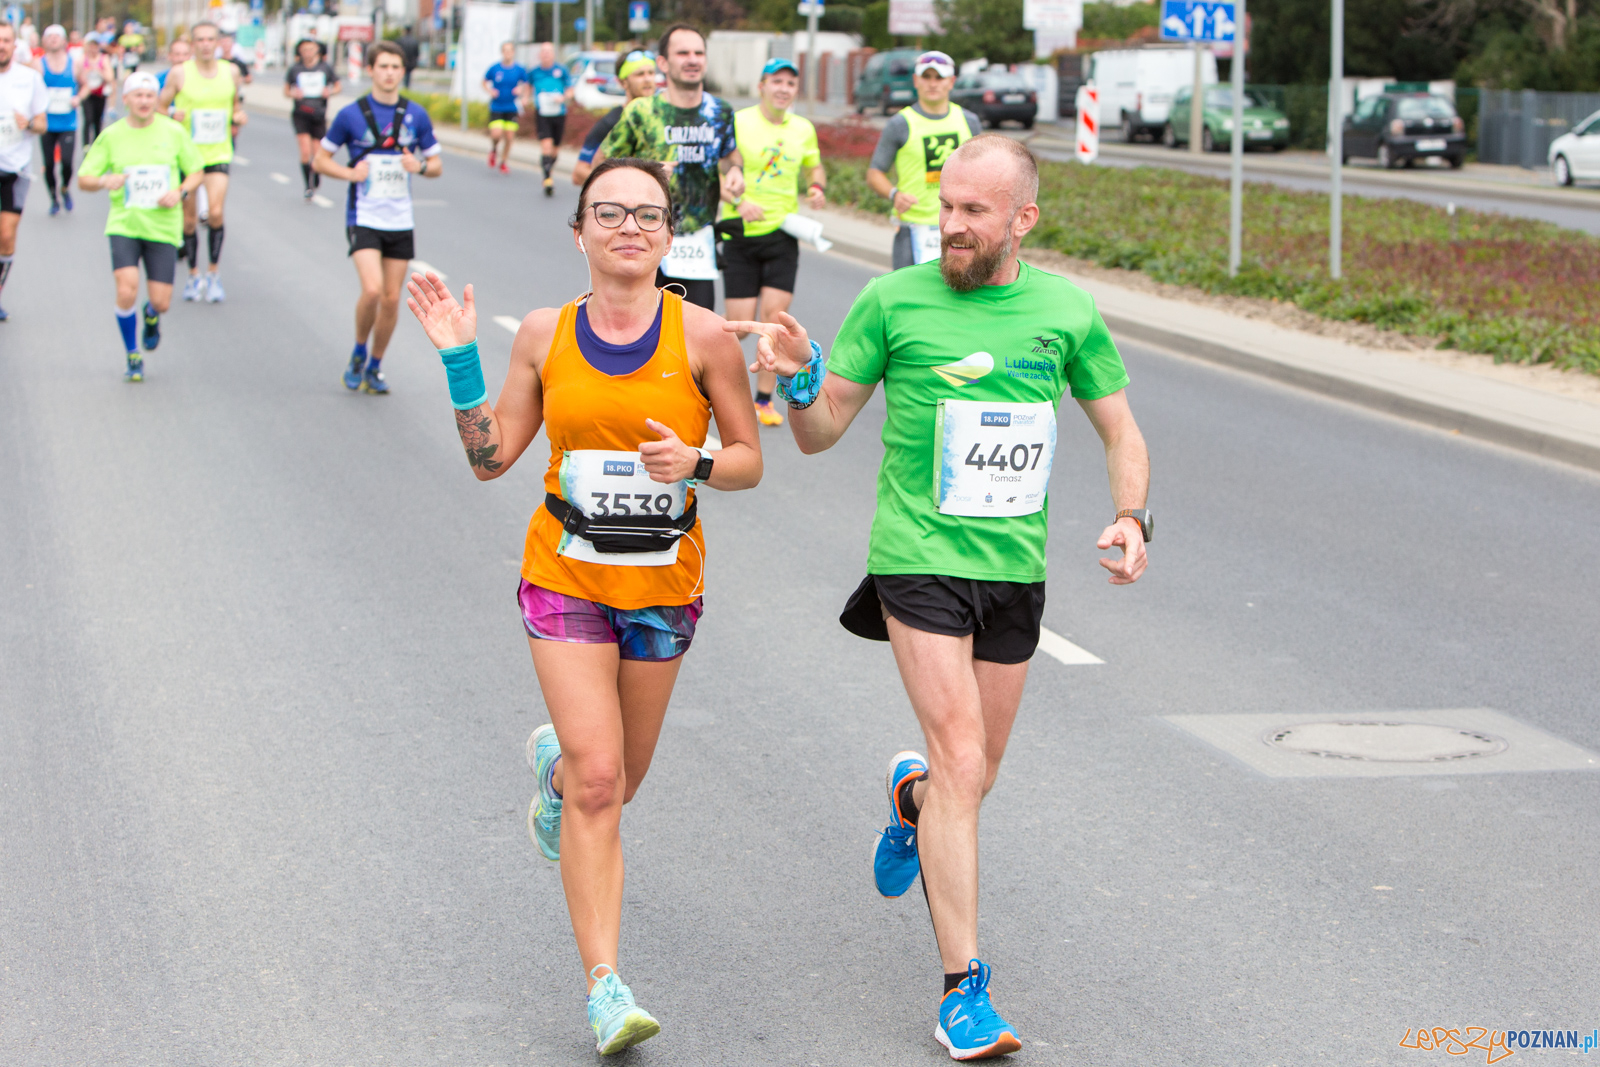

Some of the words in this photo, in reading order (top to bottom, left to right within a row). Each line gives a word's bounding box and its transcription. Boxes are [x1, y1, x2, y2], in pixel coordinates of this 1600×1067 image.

[664, 122, 715, 145] CHRZANÓW
[678, 145, 705, 163] BIEGA
[671, 246, 705, 259] 3526
[1005, 357, 1056, 372] Lubuskie
[1007, 370, 1029, 378] Warte
[983, 415, 993, 423] 18.
[994, 415, 1009, 423] PKO
[965, 443, 1044, 471] 4407
[606, 464, 615, 472] 18.
[616, 464, 633, 472] PKO
[989, 473, 1022, 482] Tomasz
[590, 492, 673, 516] 3539
